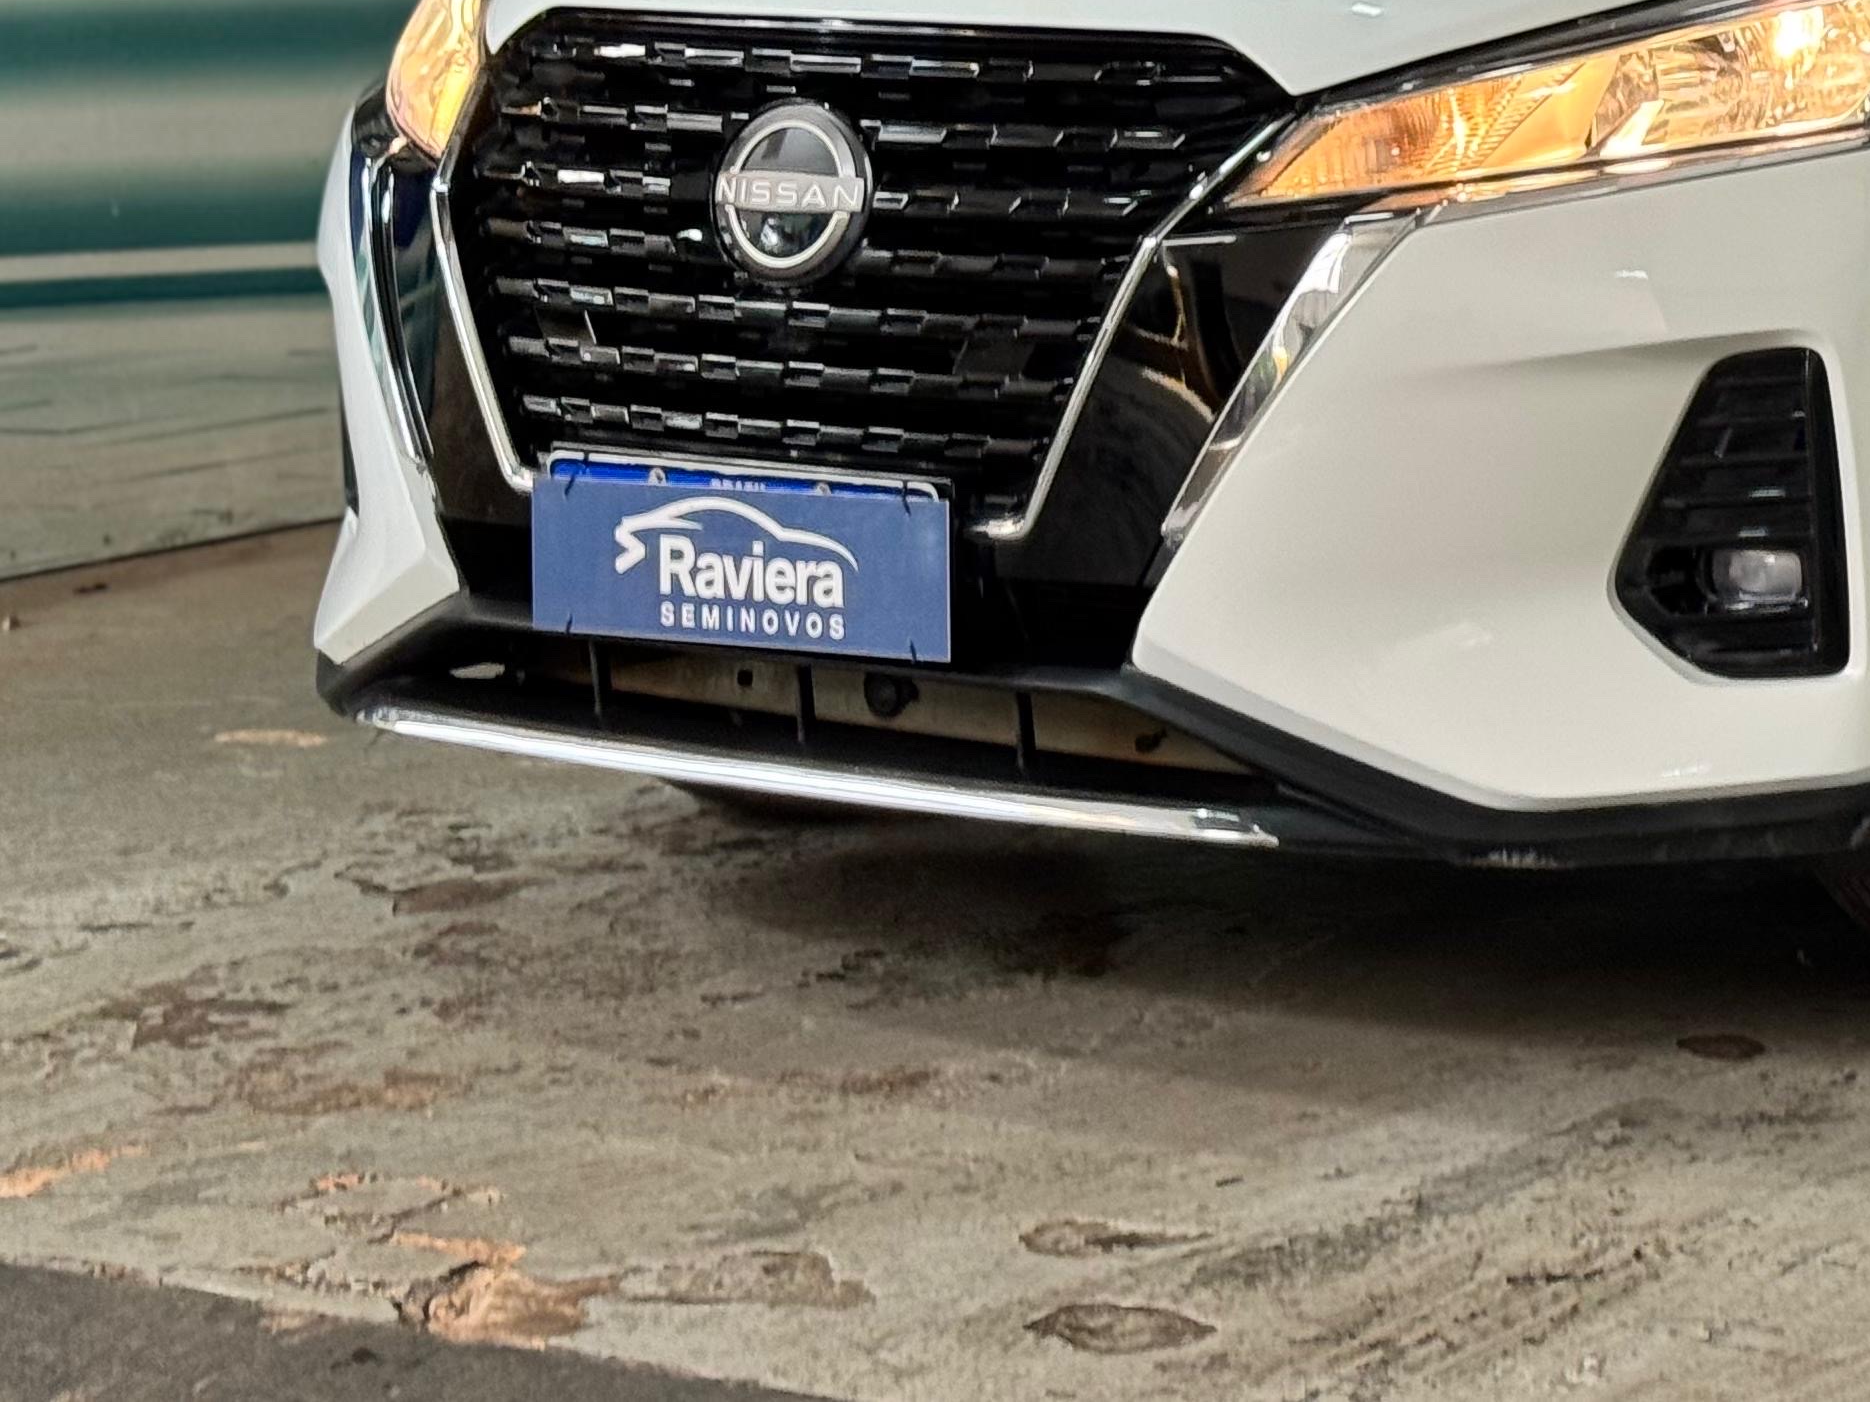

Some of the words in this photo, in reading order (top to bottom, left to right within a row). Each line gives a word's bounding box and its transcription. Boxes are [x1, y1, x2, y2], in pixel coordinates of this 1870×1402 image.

[718, 176, 859, 209] NISSAN
[659, 533, 845, 609] Raviera
[659, 600, 847, 640] SEMINOVOS
